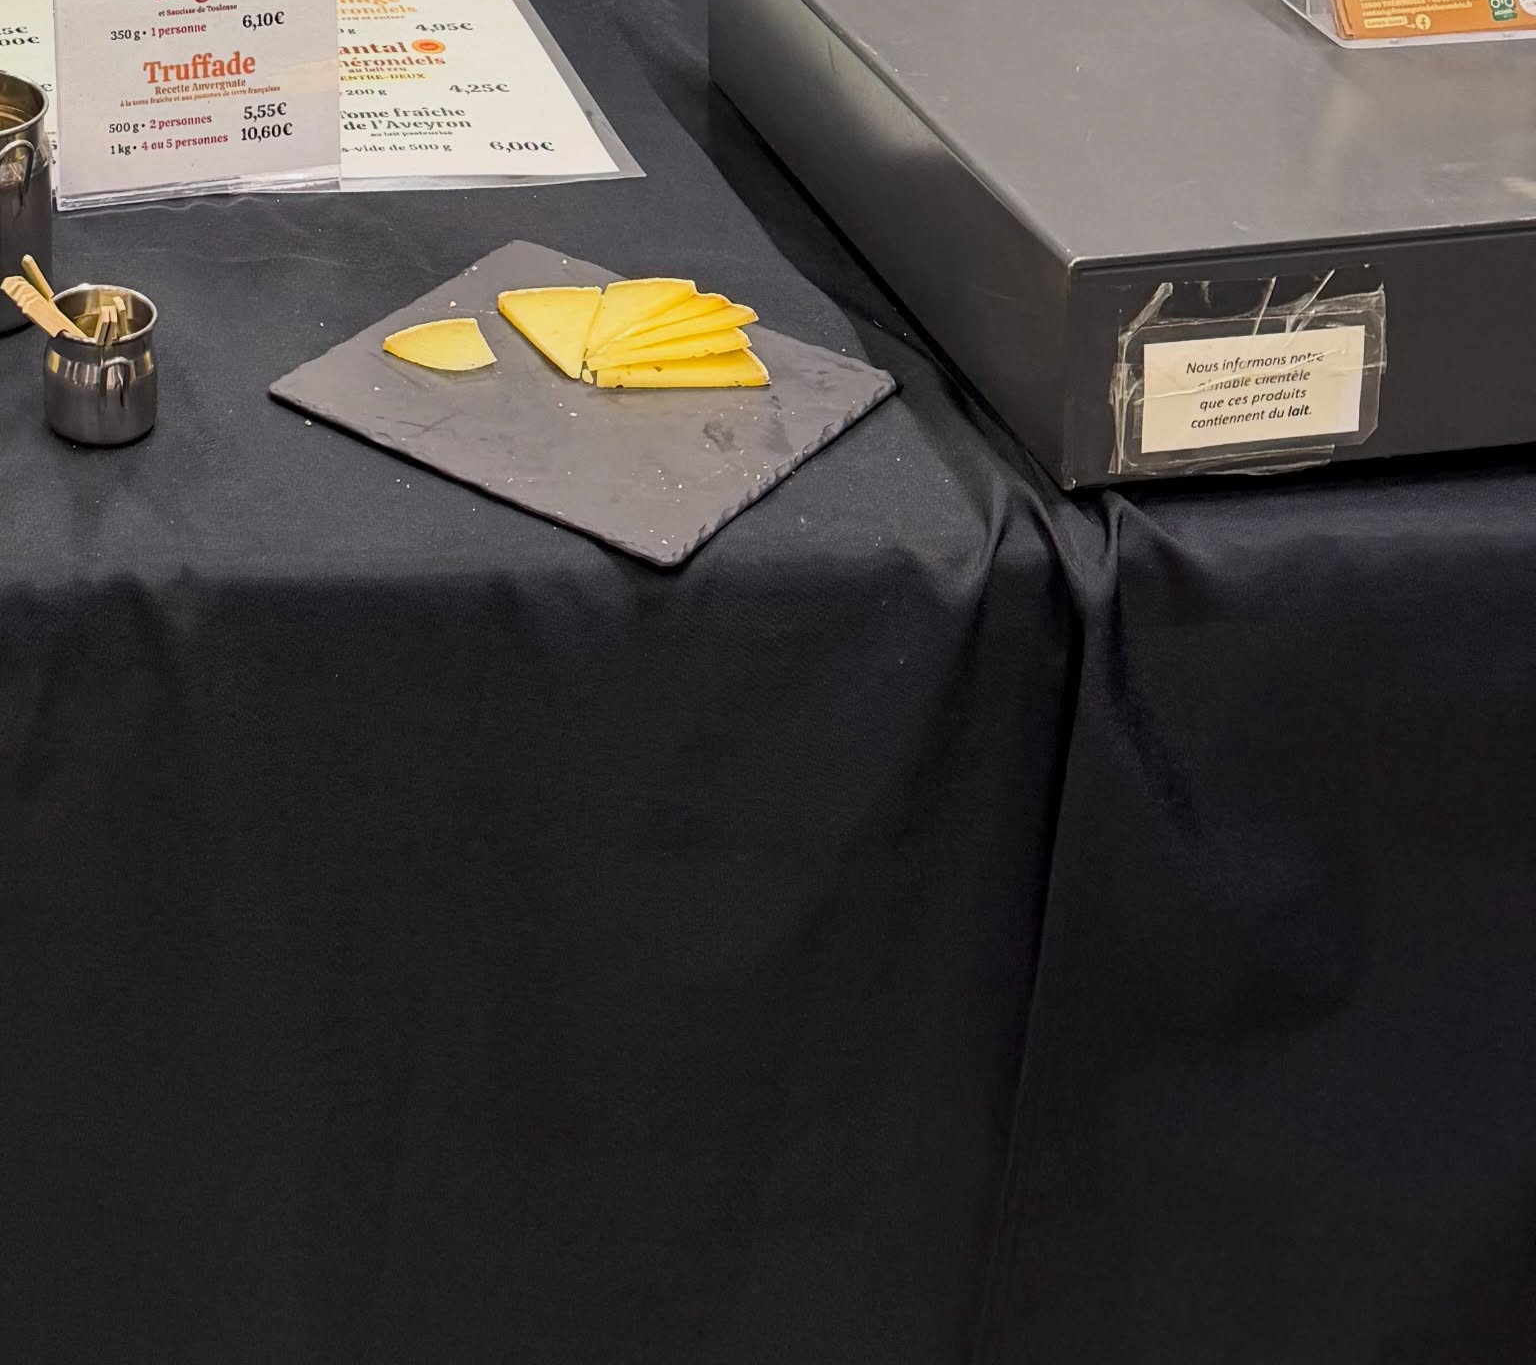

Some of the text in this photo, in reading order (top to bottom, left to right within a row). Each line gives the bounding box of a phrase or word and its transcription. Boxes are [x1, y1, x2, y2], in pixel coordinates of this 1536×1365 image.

[110, 11, 285, 41] 350 g 1 personne 6,10€
[143, 51, 256, 84] Truffade
[154, 79, 246, 96] Recette Auvergnate
[449, 84, 512, 95] 4,25€
[108, 102, 287, 134] 500 g 2 personnes 5,55€
[393, 107, 466, 118] fraîche
[343, 121, 367, 130] de
[110, 122, 293, 156] 1 kg 4 ou 5 personnes 10,60€
[490, 141, 555, 153] 6,00€
[1186, 351, 1324, 375] Nous informons notre
[1200, 387, 1307, 412] que ces produits
[1191, 405, 1312, 429] contiennent du lait.
